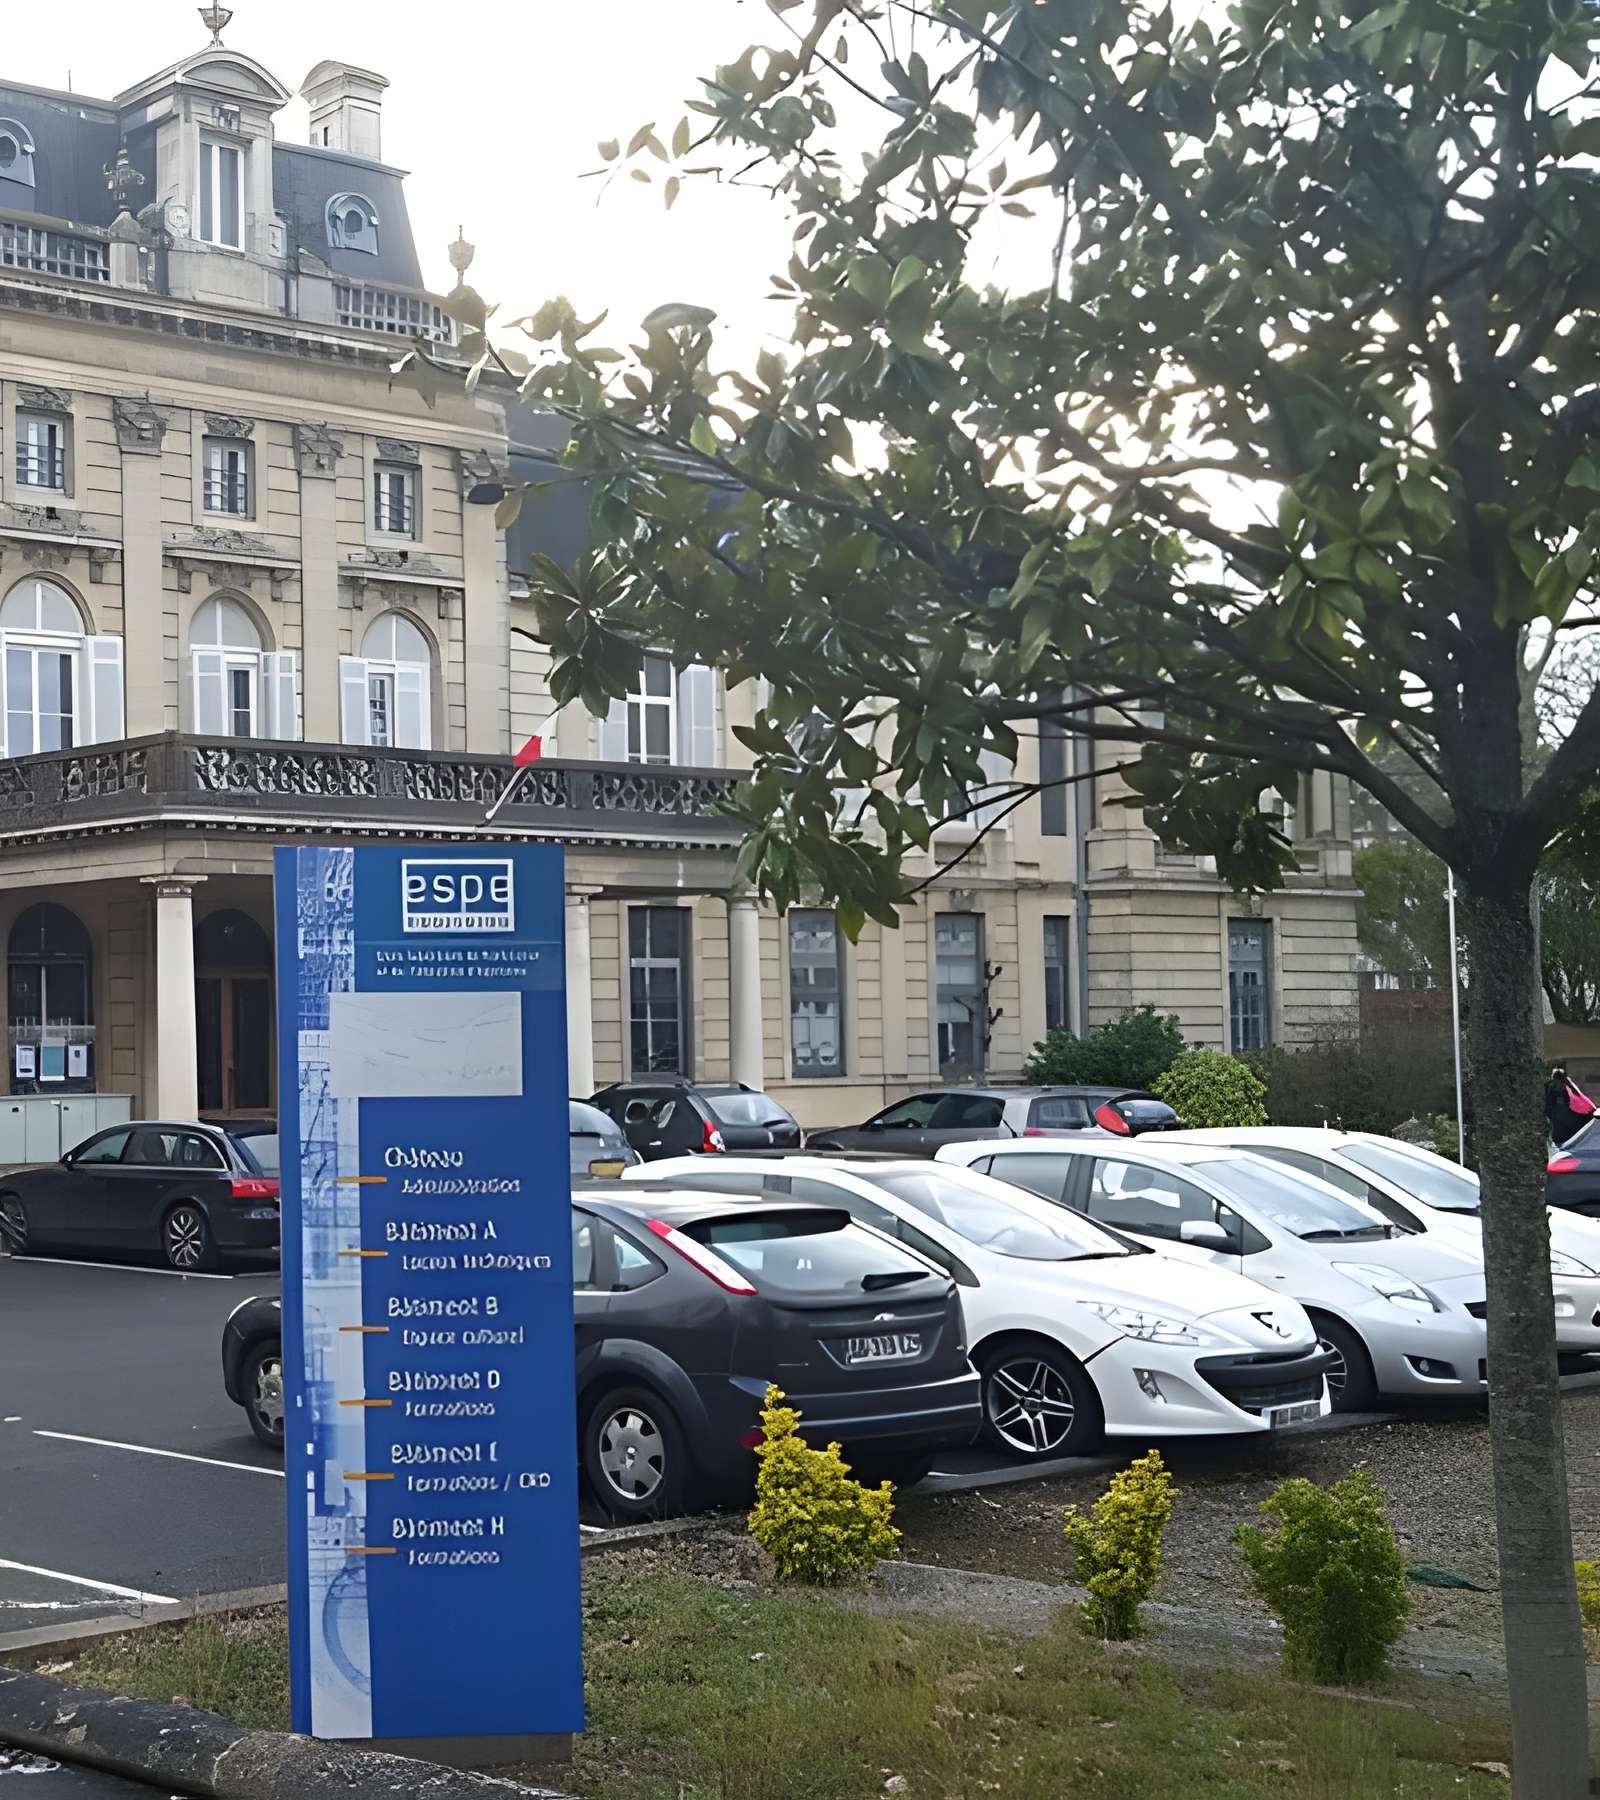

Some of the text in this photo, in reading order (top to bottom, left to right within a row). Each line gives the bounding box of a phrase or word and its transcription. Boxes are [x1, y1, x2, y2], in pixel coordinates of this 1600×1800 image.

[407, 874, 509, 913] espe
[483, 1220, 497, 1240] A
[486, 1296, 499, 1315] B
[491, 1516, 504, 1535] H
